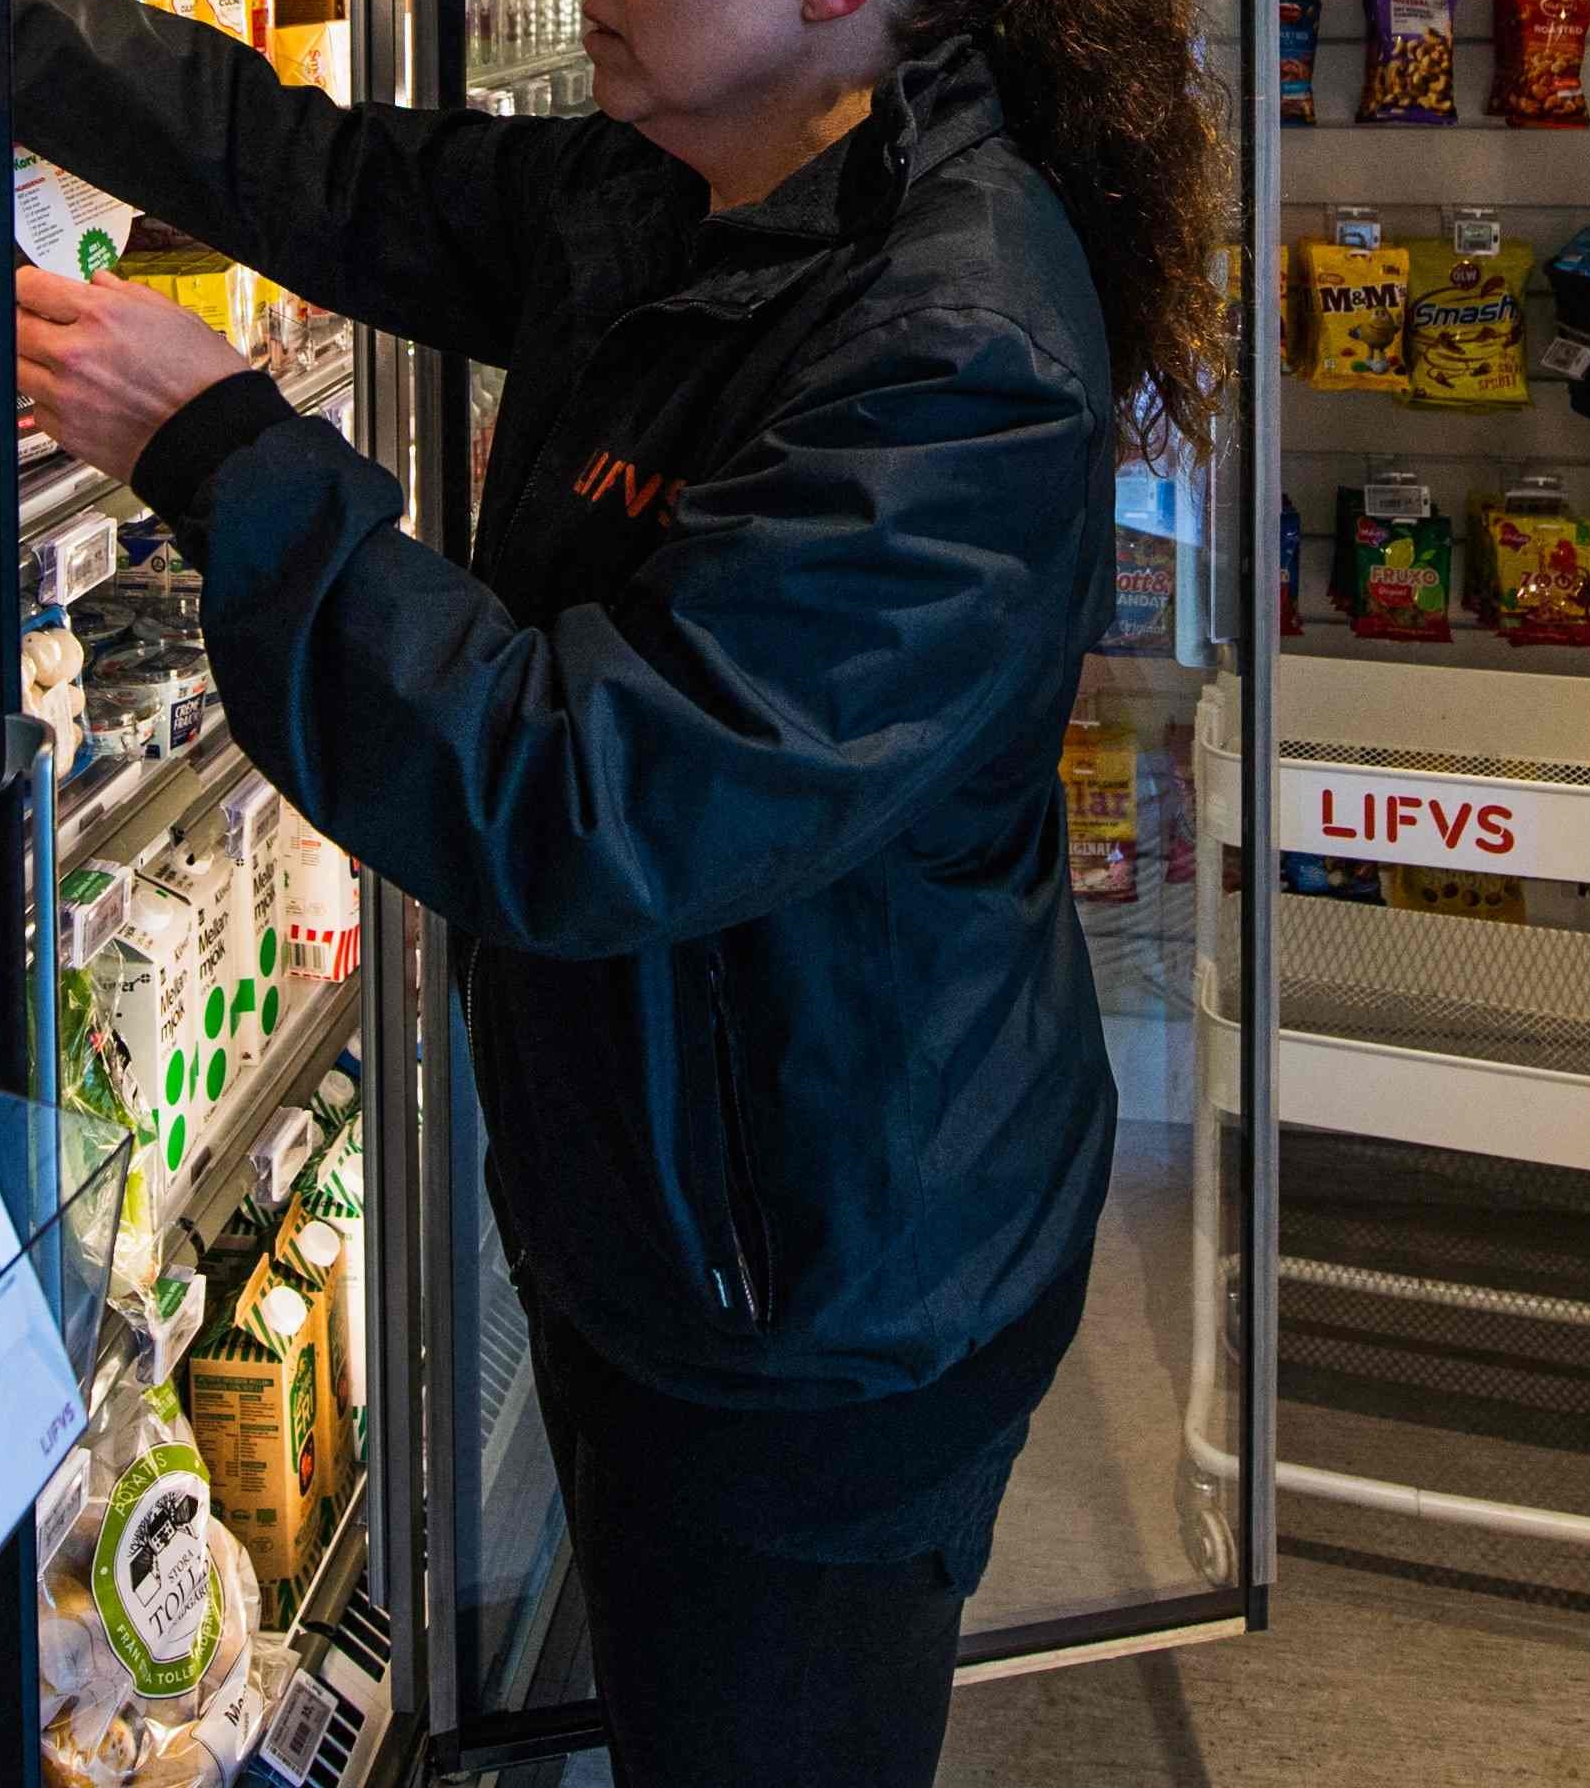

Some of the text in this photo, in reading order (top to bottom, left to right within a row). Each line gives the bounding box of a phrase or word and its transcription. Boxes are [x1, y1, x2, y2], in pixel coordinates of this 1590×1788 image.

[1413, 295, 1517, 328] Smash
[1116, 569, 1172, 594] ott&
[1117, 593, 1170, 609] ANDAT
[1321, 788, 1516, 856] LIFVS
[39, 1400, 76, 1456] LIFVS
